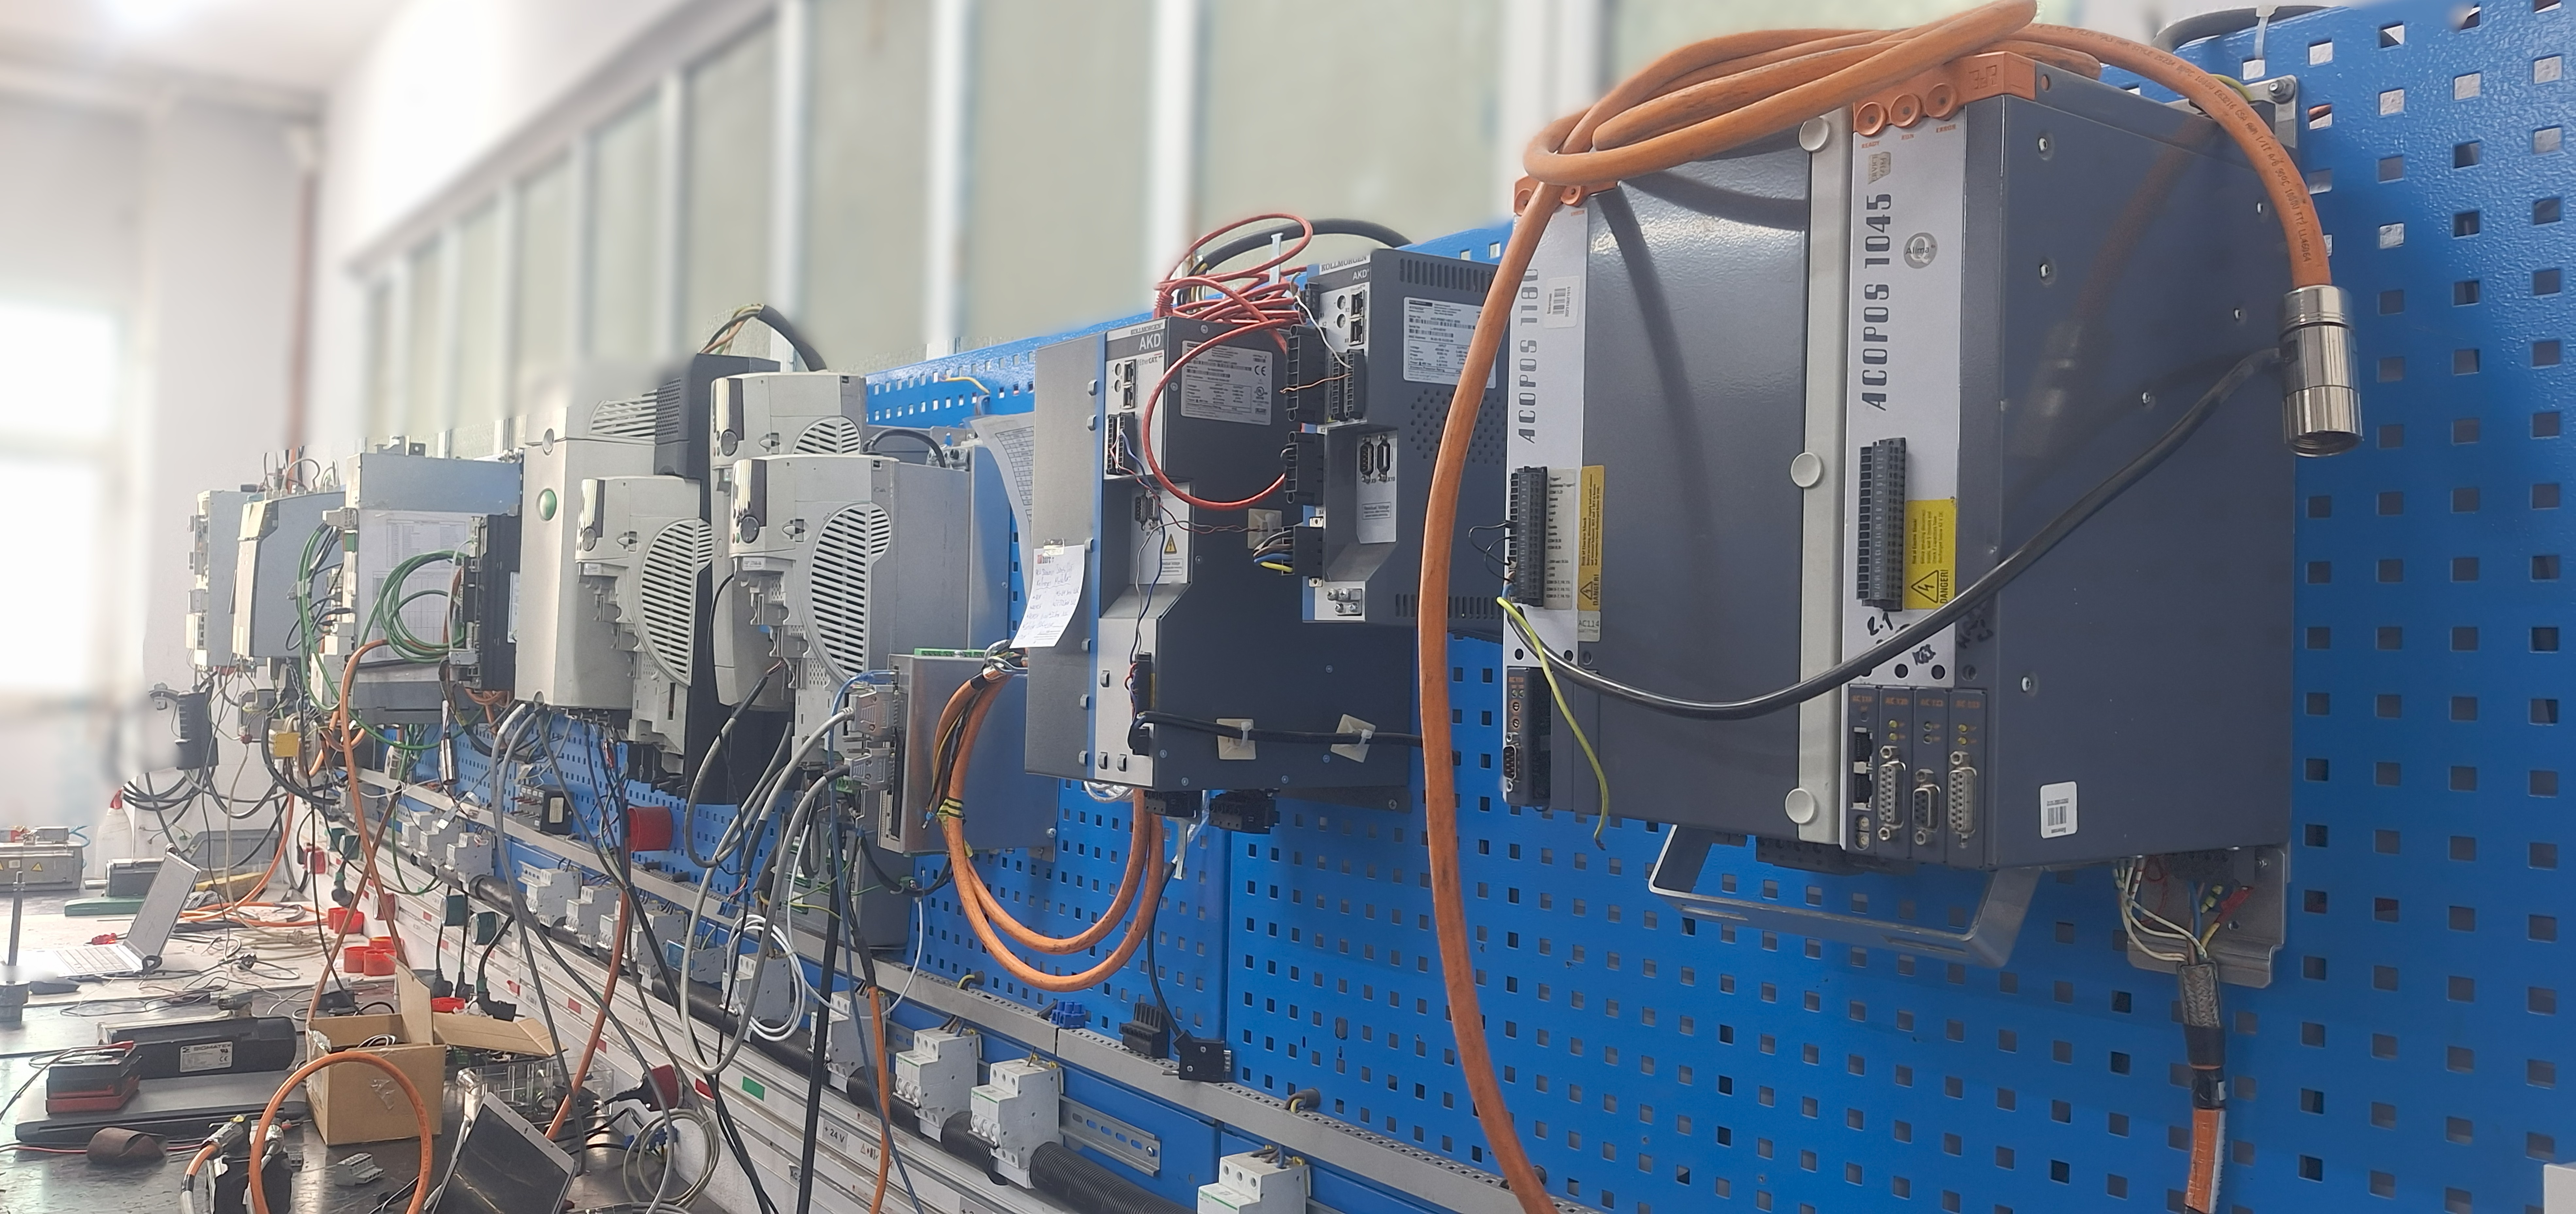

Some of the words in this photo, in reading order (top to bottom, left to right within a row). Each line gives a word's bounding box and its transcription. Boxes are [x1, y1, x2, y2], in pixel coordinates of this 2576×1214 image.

[1861, 141, 1880, 149] READY
[1865, 194, 1892, 269] 1045
[1353, 269, 1367, 281] AKD
[1139, 333, 1161, 351] AKD
[1861, 284, 1889, 411] ACOPOS
[1518, 340, 1537, 444] ACOPOS
[1939, 569, 1949, 603] DANGER!
[790, 1170, 798, 1180] AC
